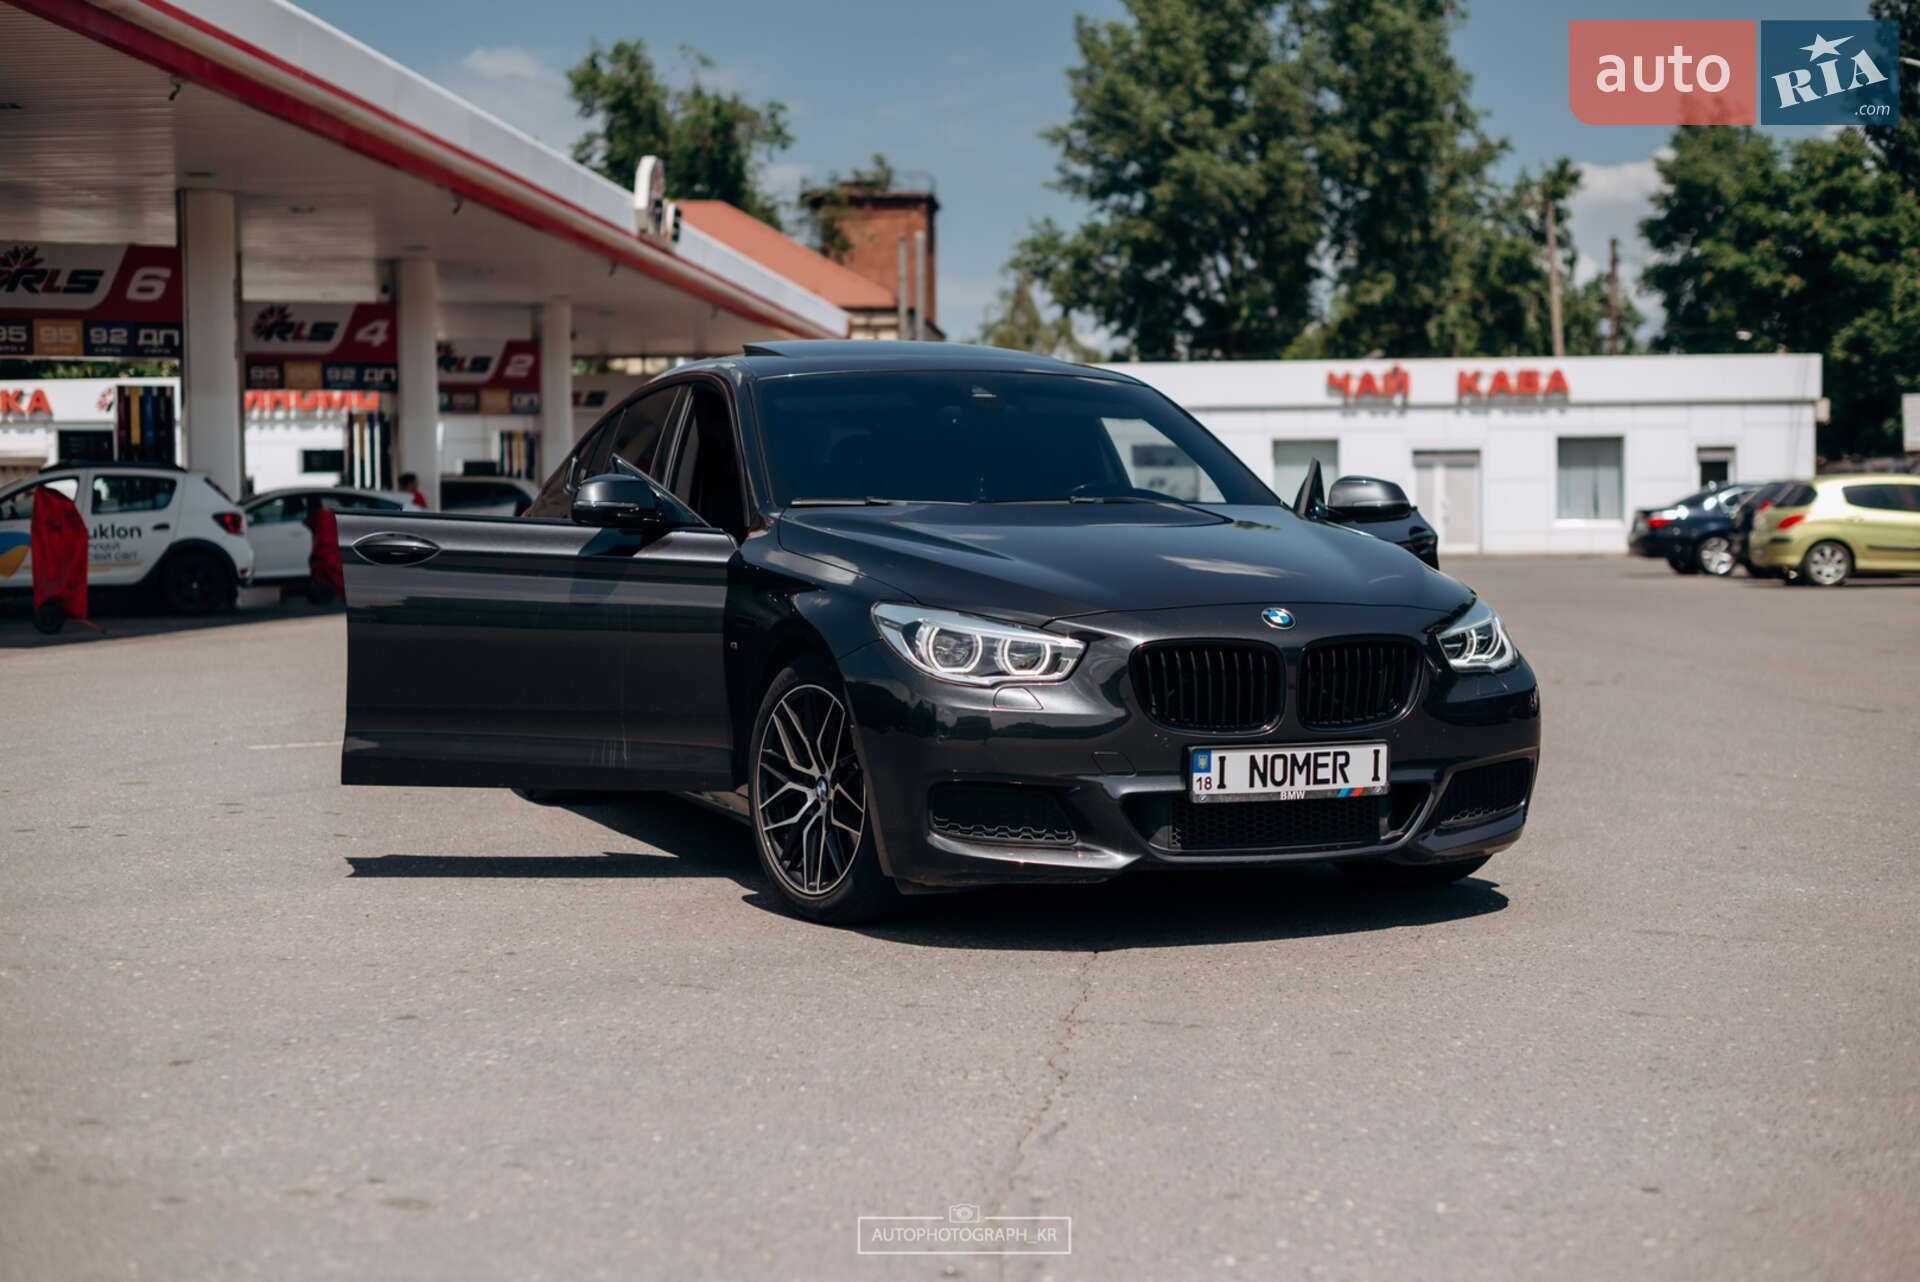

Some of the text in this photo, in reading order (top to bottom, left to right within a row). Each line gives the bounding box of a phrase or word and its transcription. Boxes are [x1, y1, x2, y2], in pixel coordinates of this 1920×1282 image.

[126, 267, 172, 302] 6
[89, 327, 129, 345] 92
[354, 319, 390, 347] 4
[503, 353, 535, 378] 2
[1327, 363, 1569, 397] ЧАЙ КАВА
[1249, 751, 1351, 788] NOMER
[1196, 776, 1213, 790] 18
[1280, 790, 1306, 801] BMW
